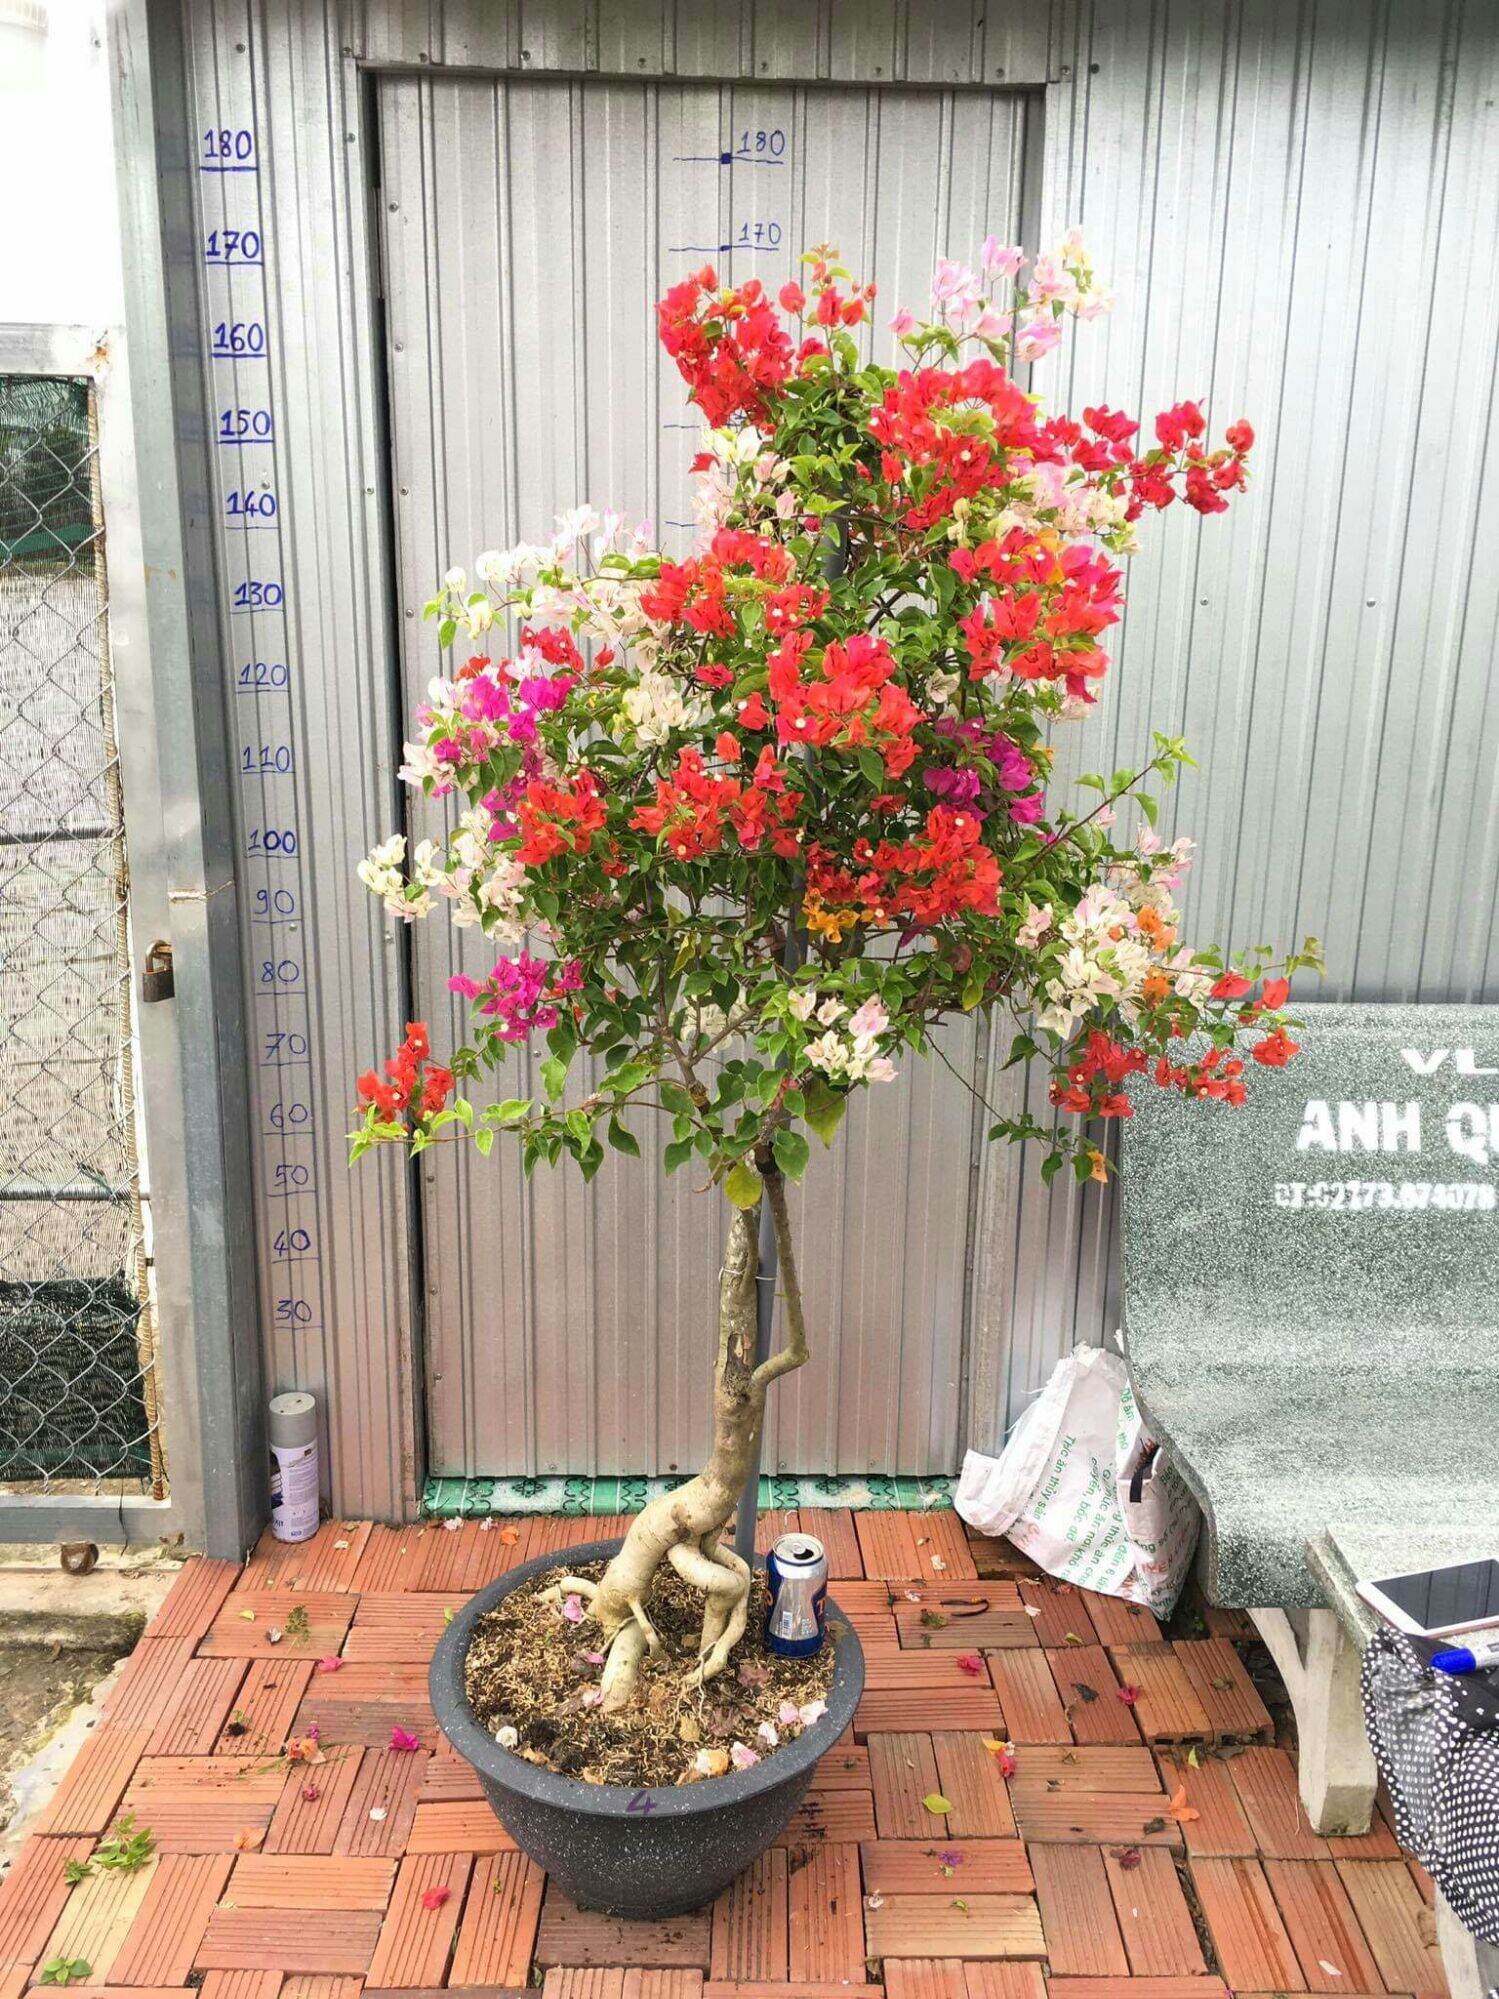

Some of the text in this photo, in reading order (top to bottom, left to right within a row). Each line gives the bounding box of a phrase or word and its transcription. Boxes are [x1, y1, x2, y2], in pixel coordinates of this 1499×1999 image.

[204, 129, 252, 160] 180
[737, 129, 785, 156] 180
[205, 230, 260, 260] 170
[739, 223, 781, 244] 170
[213, 322, 264, 351] 160
[219, 409, 271, 436] 150
[226, 490, 276, 517] 140
[234, 581, 283, 607] 130
[238, 663, 288, 686] 120
[242, 745, 291, 772] 110
[248, 829, 296, 854] 100
[256, 889, 295, 914] 90
[261, 960, 299, 984] 80
[264, 1033, 307, 1060] 70
[270, 1103, 308, 1129] 60
[1297, 1098, 1499, 1165] ANH Q
[274, 1164, 309, 1187] 50
[274, 1229, 311, 1254] 40
[274, 1300, 312, 1323] 30
[626, 1789, 658, 1817] 4
